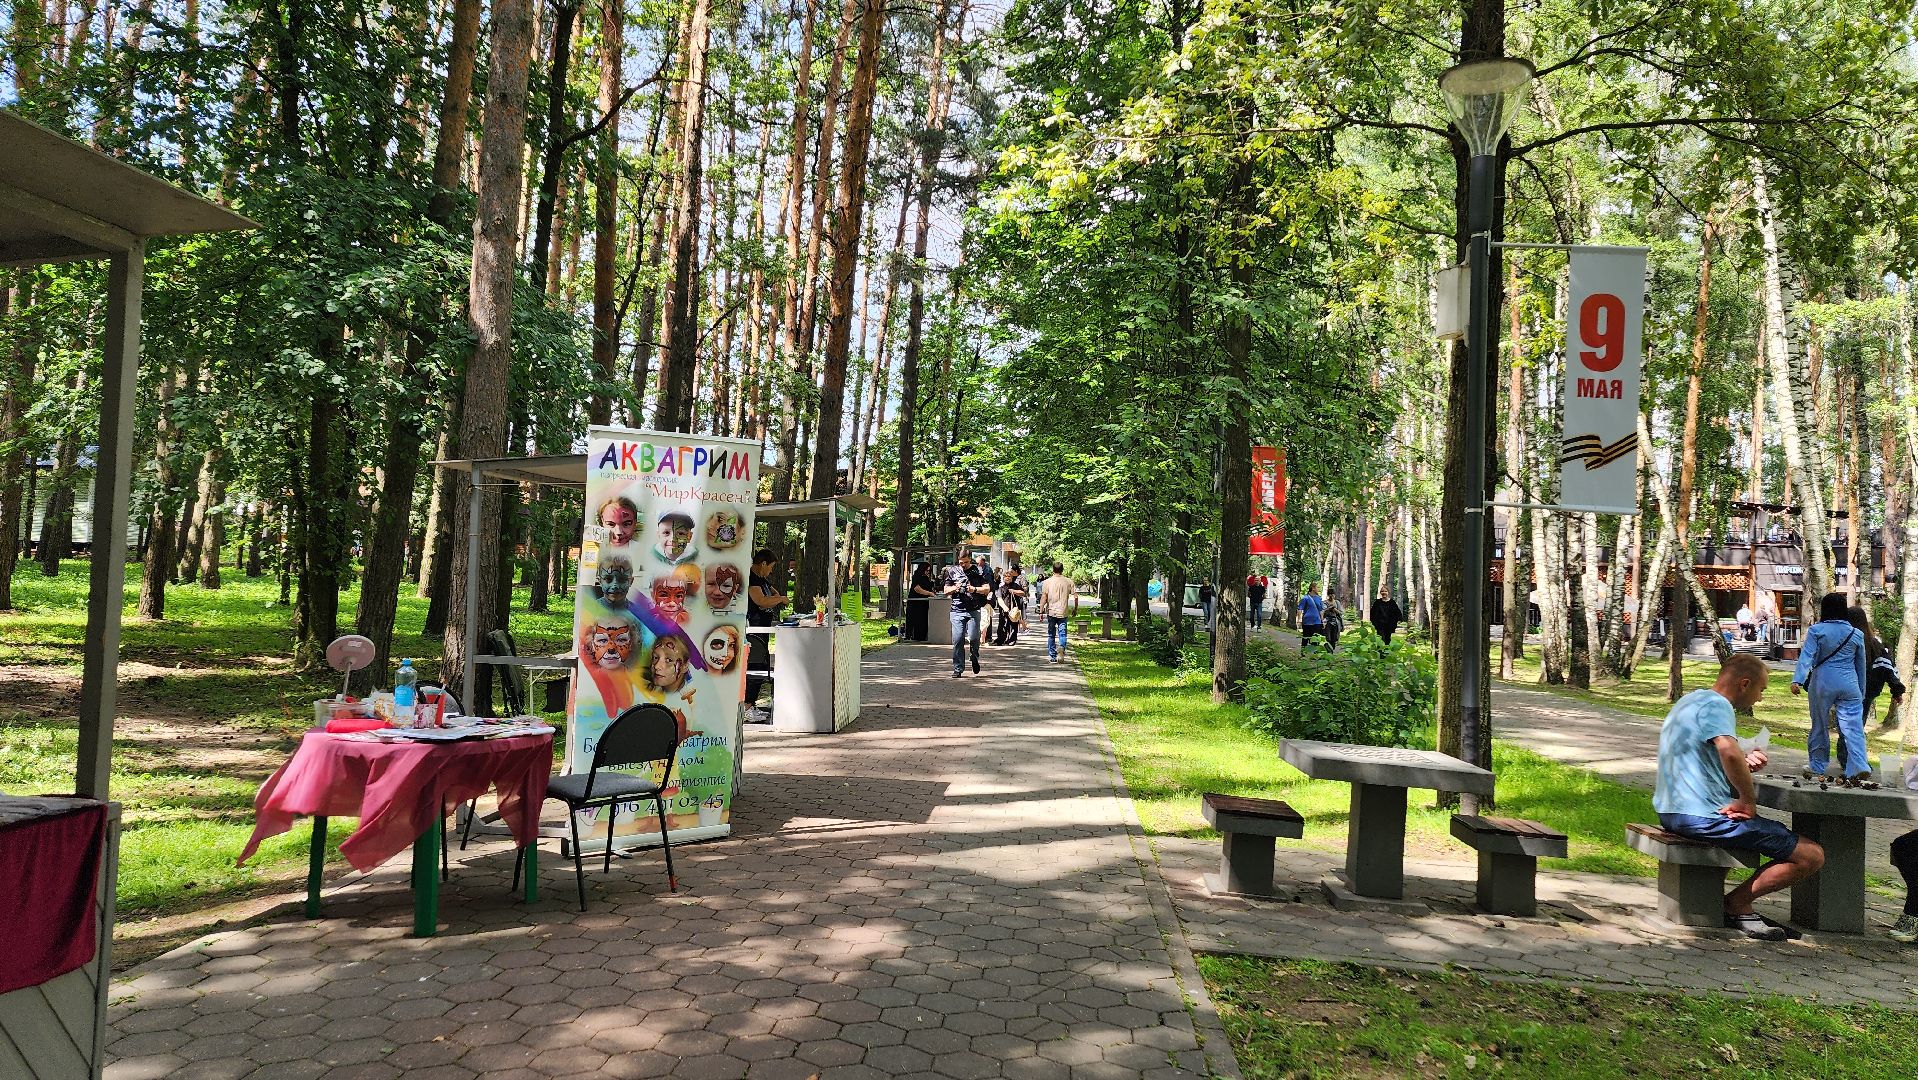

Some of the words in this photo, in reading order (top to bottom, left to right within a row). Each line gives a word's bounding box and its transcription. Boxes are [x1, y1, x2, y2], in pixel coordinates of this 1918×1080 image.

[1579, 293, 1625, 373] 9
[1577, 377, 1623, 400] МАЯ
[599, 441, 751, 482] АКВАГРИМ
[678, 735, 728, 752] вагрим
[678, 757, 705, 769] дом
[679, 796, 700, 808] 02
[704, 794, 725, 810] 45
